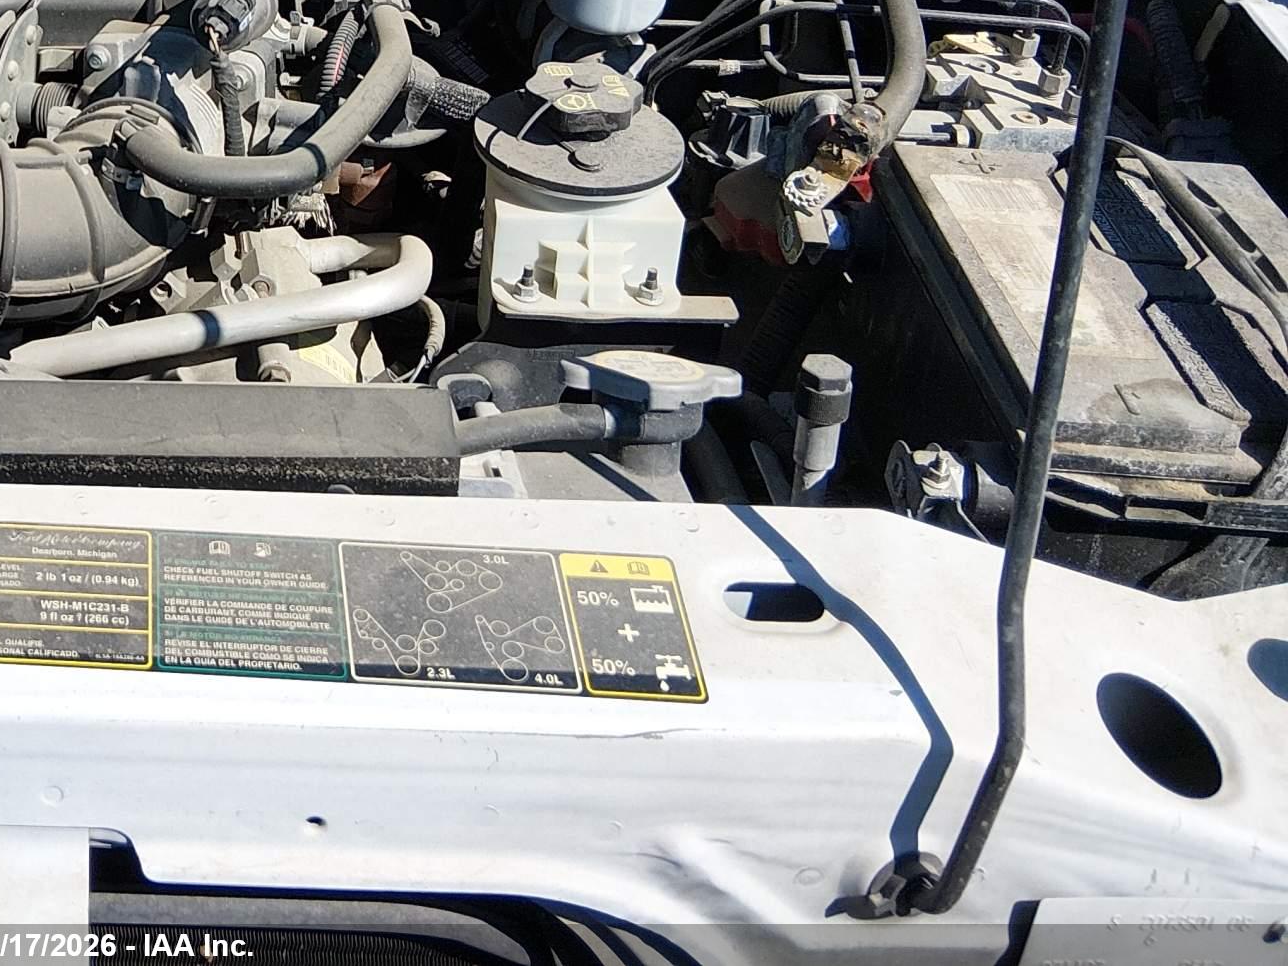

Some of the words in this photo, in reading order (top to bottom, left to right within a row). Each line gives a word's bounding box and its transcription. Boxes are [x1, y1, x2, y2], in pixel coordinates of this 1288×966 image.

[77, 549, 118, 559] Michigan
[482, 553, 510, 566] 3.0L
[35, 571, 44, 582] 2
[45, 572, 57, 582] lb
[69, 574, 82, 584] oz
[91, 574, 118, 586] (0.94
[120, 575, 140, 588] kg)
[164, 565, 195, 575] CHECK
[196, 567, 220, 576] FUEL
[221, 568, 262, 578] SHUTOFF
[263, 571, 299, 580] SWITCH
[299, 573, 312, 581] AS
[164, 573, 224, 583] REFERENCED
[225, 577, 235, 585] IN
[236, 577, 262, 587] YOUR
[262, 579, 297, 588] OWNER
[298, 580, 329, 590] GUIDE.
[40, 599, 130, 613] WSH-M1C231-B
[575, 589, 620, 608] 50%
[164, 605, 177, 614] DE
[238, 608, 272, 619] COMME
[206, 599, 219, 608] LA
[220, 600, 273, 611] COMMANDE
[274, 602, 288, 612] DE
[289, 604, 334, 615] COUPURE
[40, 610, 47, 621] 9
[49, 611, 58, 622] fl
[61, 613, 74, 623] oz
[84, 613, 109, 625] (266
[111, 615, 130, 626] cc)
[164, 613, 190, 622] DANS
[191, 615, 203, 623] LE
[204, 616, 233, 625] GUIDE
[235, 617, 249, 626] DE
[27, 648, 81, 659] CALIFICADO.
[164, 638, 198, 648] REVISE
[199, 640, 212, 649] EL
[213, 641, 279, 652] INTERRUPTOR
[279, 644, 293, 654] DE
[294, 646, 329, 655] CIERRE
[164, 646, 184, 655] DEL
[184, 648, 251, 659] COMBUSTIBLE
[252, 651, 281, 661] COMO
[282, 653, 296, 663] SE
[296, 654, 329, 664] INDICA
[164, 654, 178, 664] EN
[179, 656, 192, 665] LA
[217, 658, 236, 667] DEL
[237, 660, 304, 672] PROPIETARIO.
[426, 667, 456, 680] 2.3L
[591, 658, 636, 677] 50%
[534, 673, 564, 686] 4.0L
